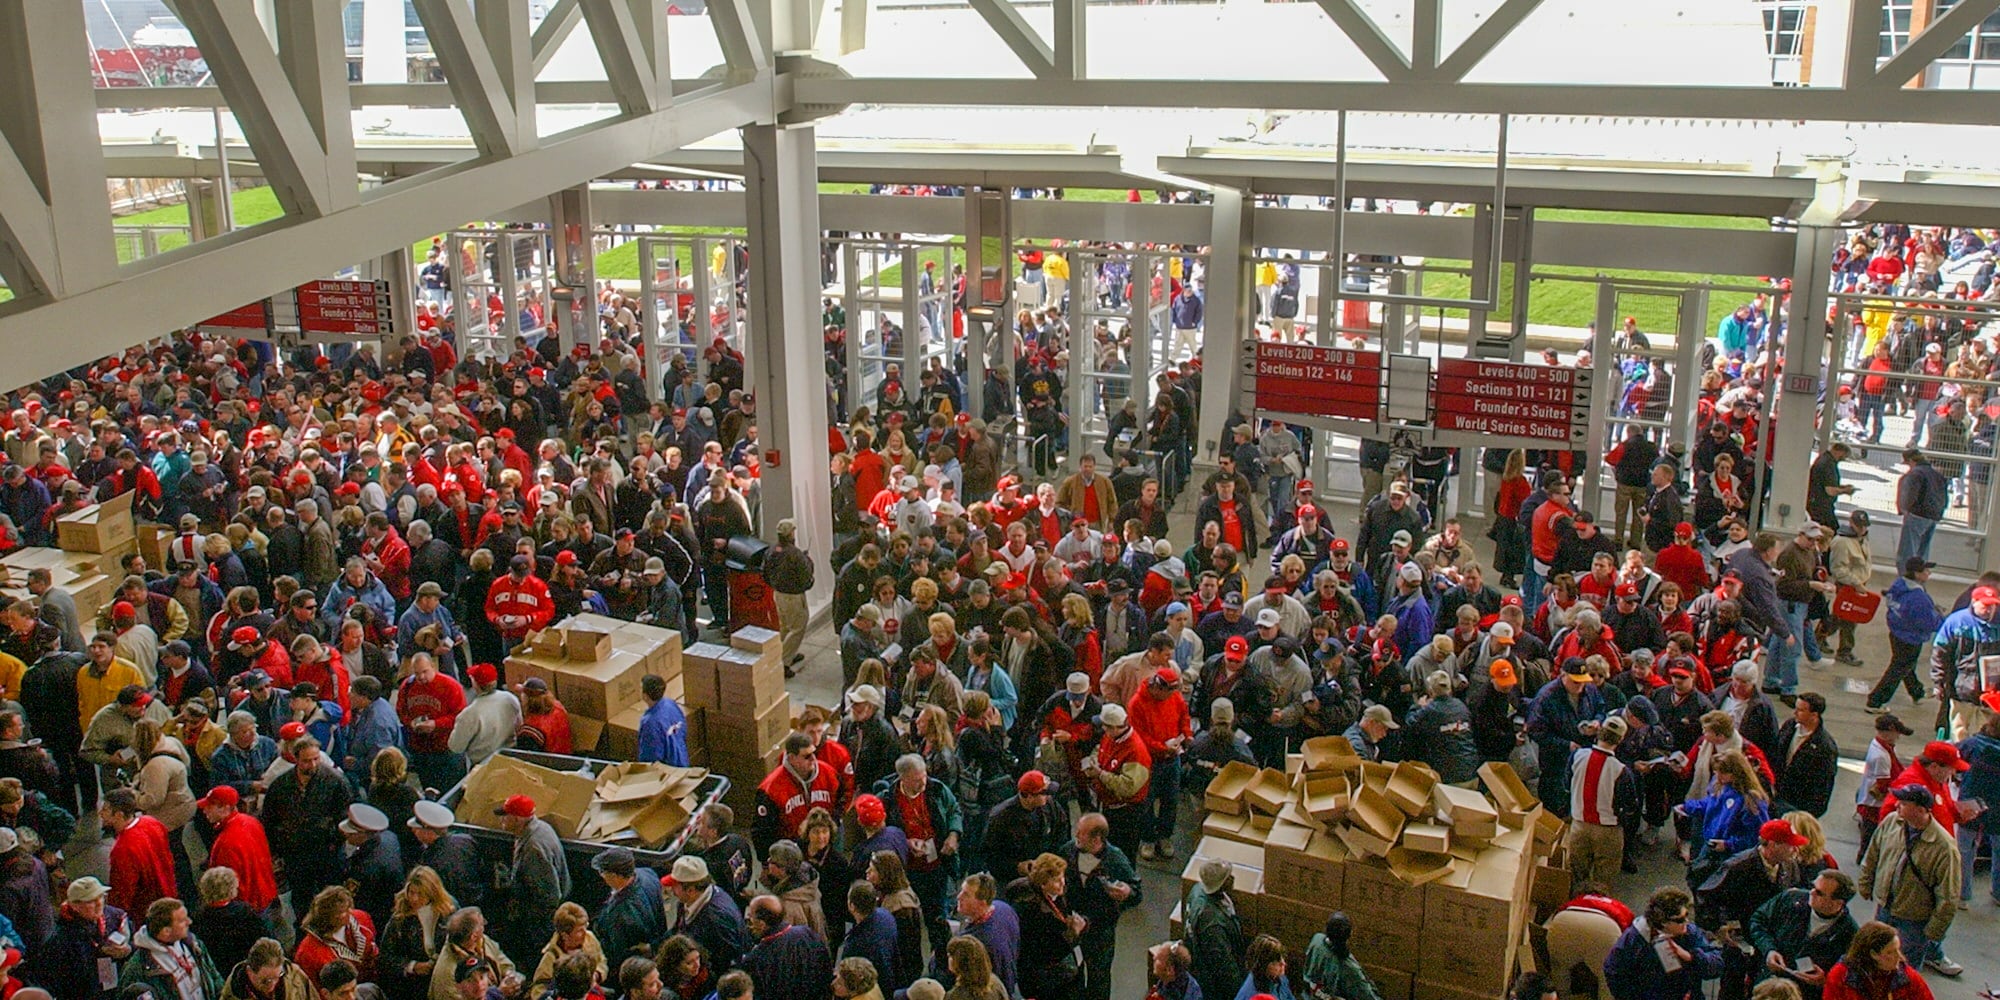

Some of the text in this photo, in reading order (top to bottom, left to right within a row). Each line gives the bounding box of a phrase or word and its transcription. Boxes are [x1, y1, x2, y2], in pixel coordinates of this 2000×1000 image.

[319, 282, 340, 291] Levels
[341, 283, 353, 292] 400
[359, 283, 372, 292] 500
[319, 294, 347, 305] Sections
[347, 296, 358, 305] 101
[362, 297, 374, 306] 121
[320, 307, 375, 319] Founder's Suites
[354, 323, 376, 333] Suites
[1261, 345, 1293, 359] Levels
[1295, 348, 1314, 361] 200
[1324, 350, 1343, 363] 300
[1260, 361, 1304, 378] Sections
[1305, 365, 1324, 379] 122
[1334, 368, 1353, 382] 146
[1478, 363, 1514, 377] Levels
[1516, 367, 1537, 381] 400
[1549, 370, 1569, 384] 500
[1465, 380, 1513, 397] Sections
[1516, 385, 1535, 398] 101
[1548, 388, 1567, 401] 121
[1474, 399, 1567, 420] Founder's Suites
[1455, 415, 1565, 438] World Series Suites
